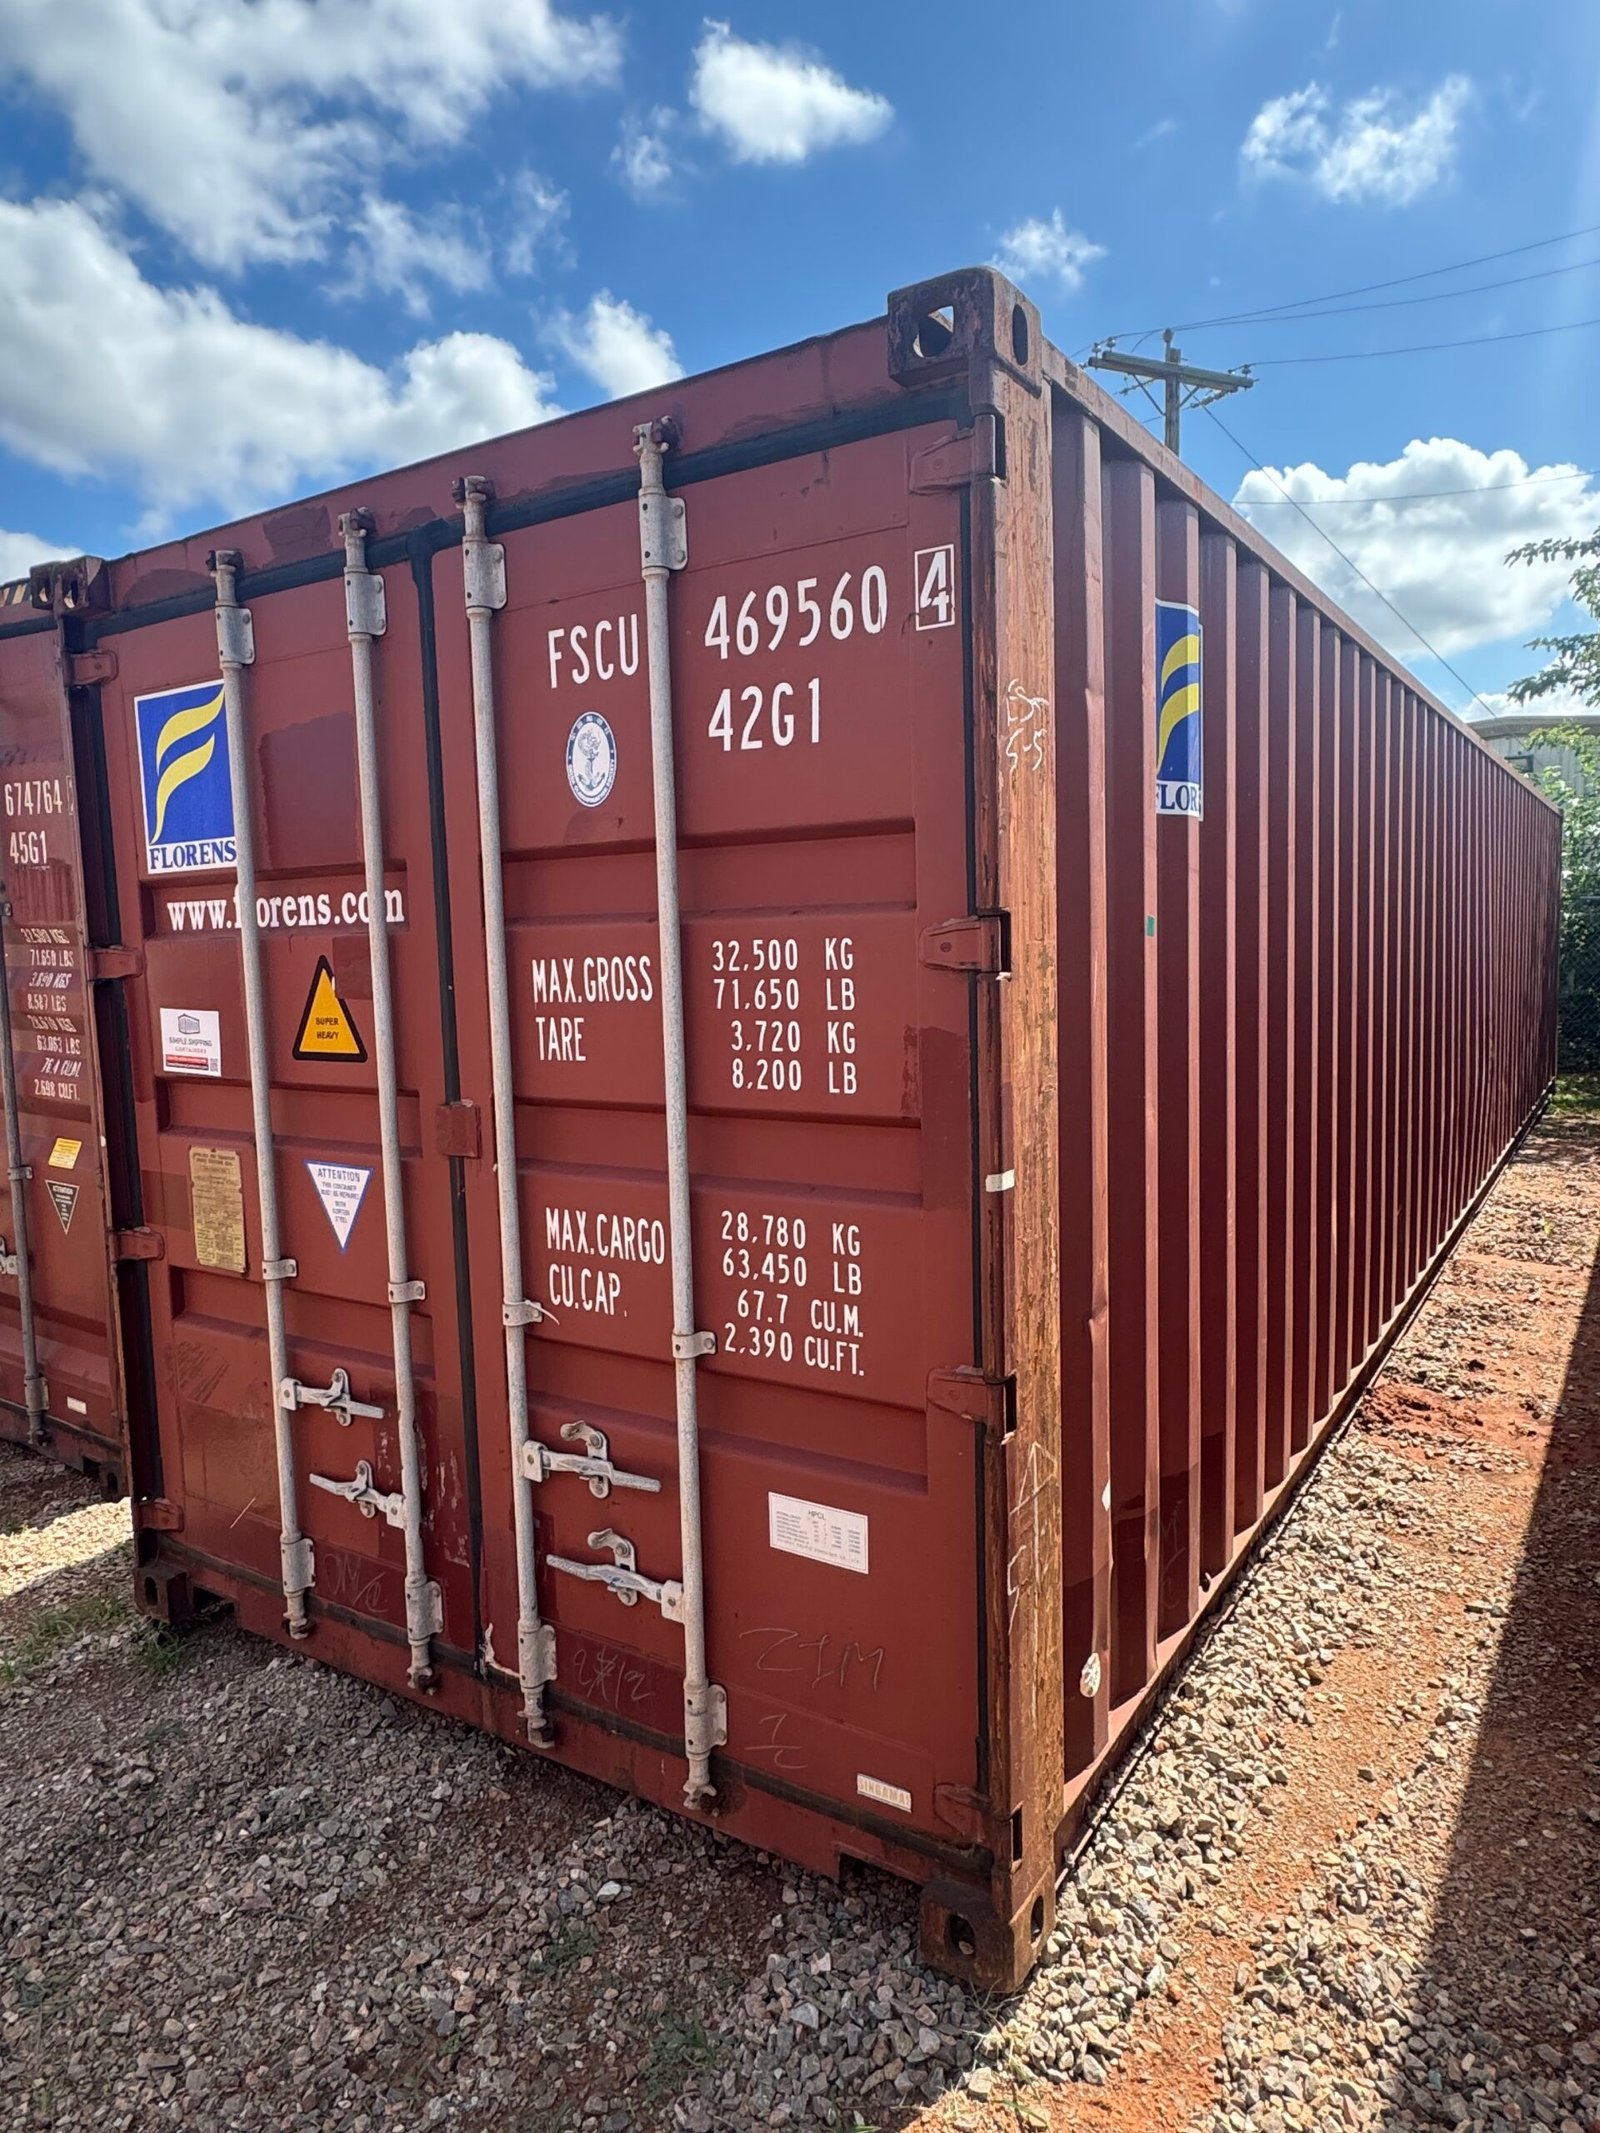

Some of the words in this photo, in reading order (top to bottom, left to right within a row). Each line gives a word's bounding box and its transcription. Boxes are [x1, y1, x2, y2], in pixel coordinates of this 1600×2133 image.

[548, 614, 639, 688] FSCU
[704, 565, 888, 660] 469560
[919, 550, 951, 622] 4
[708, 677, 820, 751] 42G1
[4, 779, 63, 816] 674764
[9, 830, 47, 864] 45G1
[150, 840, 237, 870] FLORENS
[59, 950, 74, 967] LBS
[532, 955, 653, 1003] MAX.GROSS
[712, 938, 798, 971] 32,500
[825, 938, 853, 970] KG
[51, 995, 67, 1012] LBS
[713, 978, 800, 1010] 71,650
[826, 978, 855, 1011] LB
[315, 1017, 339, 1025] SUPER
[316, 1031, 339, 1040] HEAVY
[535, 1016, 587, 1062] TARE
[731, 1020, 800, 1052] 3,720
[827, 1021, 856, 1054] KG
[65, 1036, 80, 1055] LBS
[732, 1058, 802, 1091] 8,200
[828, 1061, 857, 1094] LB
[318, 1168, 360, 1182] ATTENTION
[546, 1207, 665, 1265] MAX.CARGO
[721, 1210, 806, 1249] 28,780
[832, 1223, 860, 1256] KG
[723, 1248, 807, 1287] 63,450
[833, 1261, 862, 1295] LB
[737, 1289, 789, 1324] 67.7
[811, 1299, 864, 1338] CU.M.
[724, 1322, 793, 1362] 2,390
[804, 1336, 865, 1376] CU.FT.
[739, 1627, 884, 1692] ZIM
